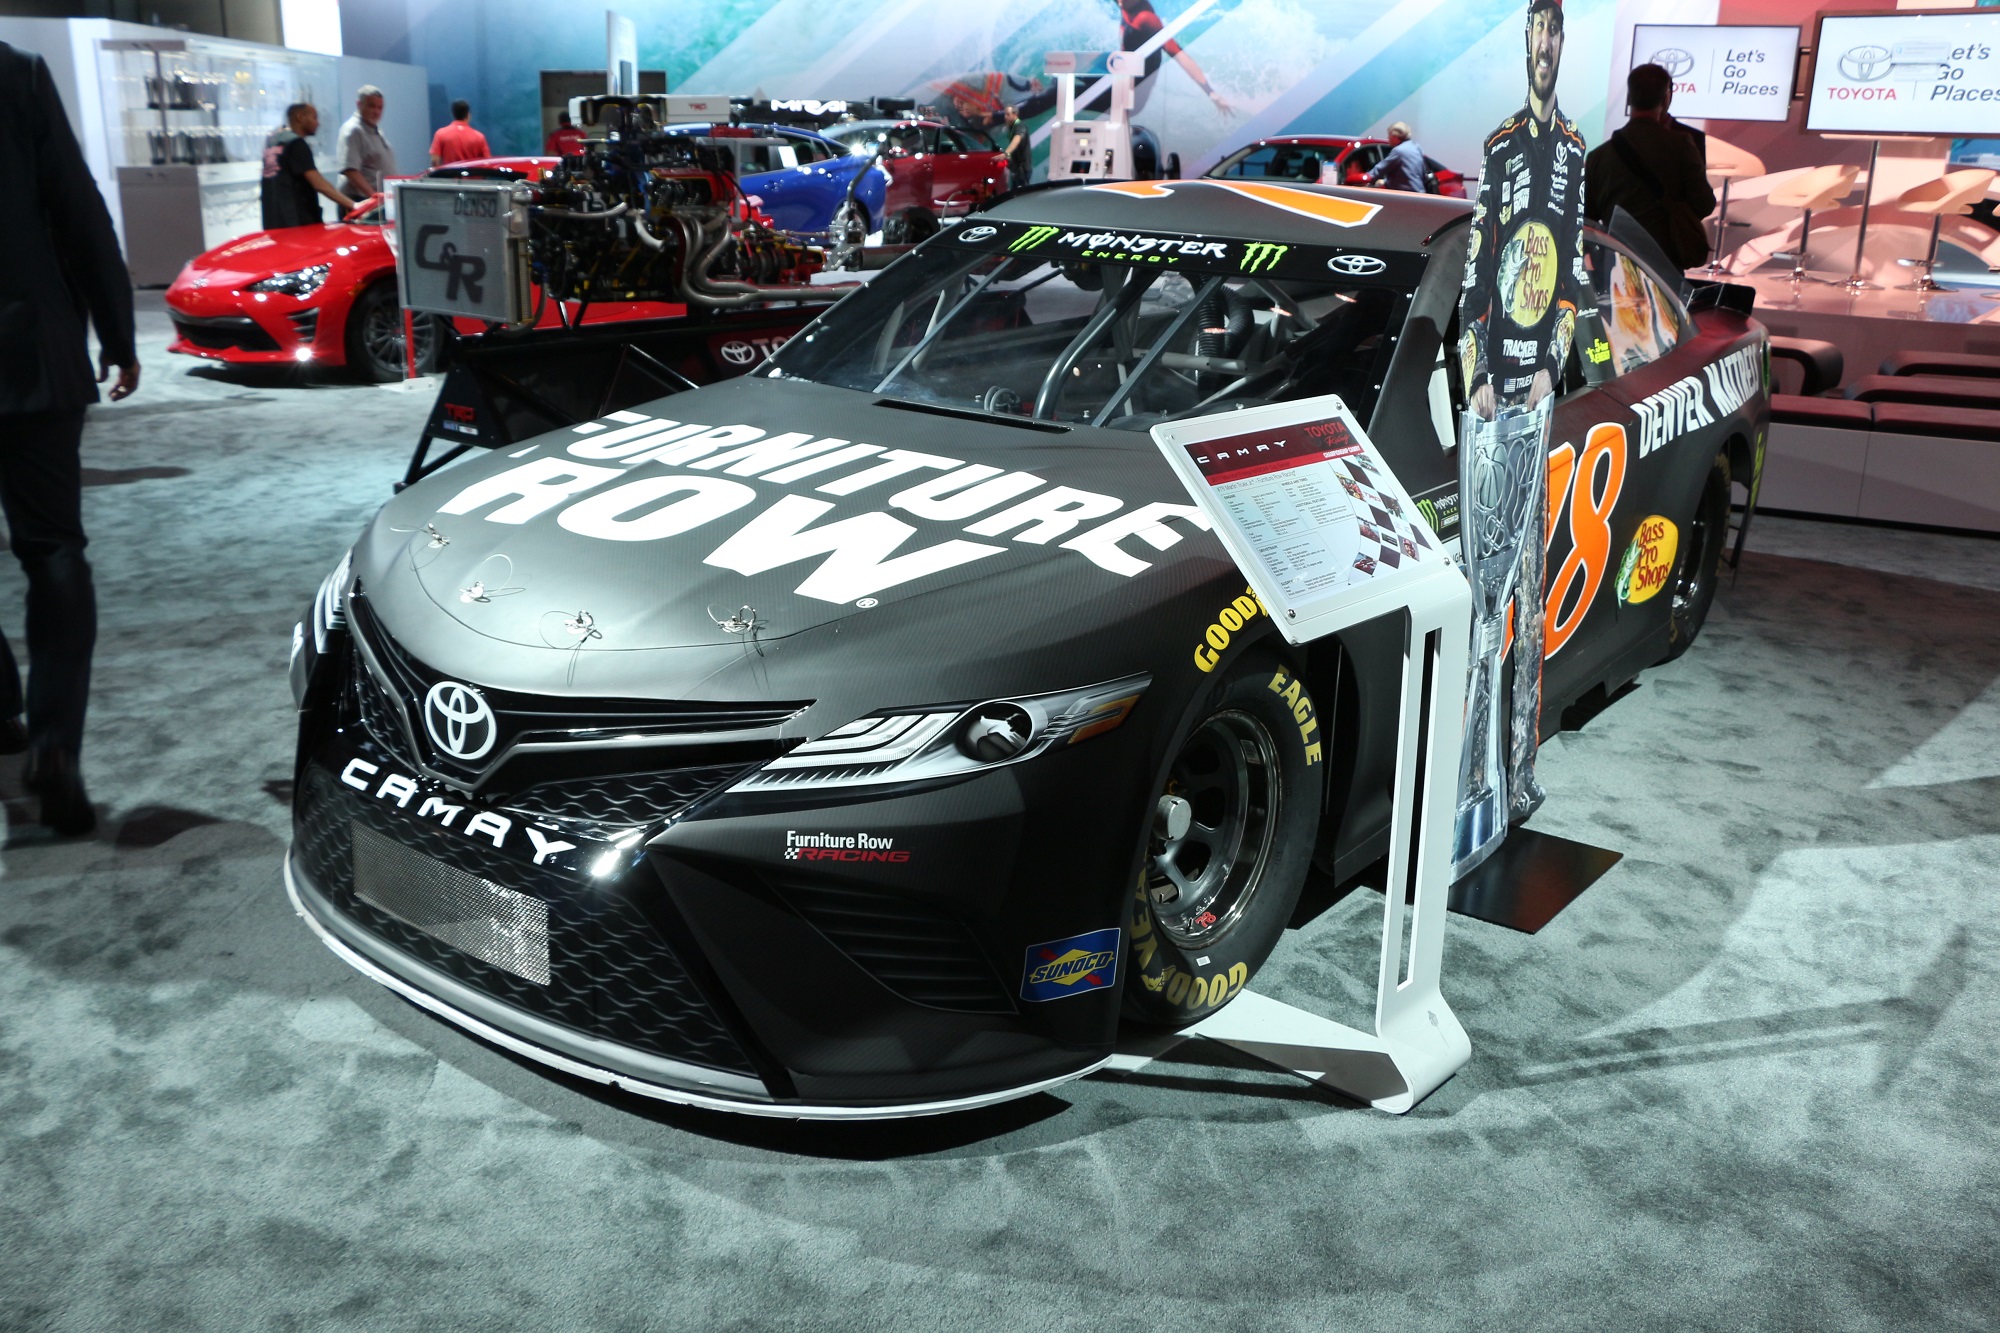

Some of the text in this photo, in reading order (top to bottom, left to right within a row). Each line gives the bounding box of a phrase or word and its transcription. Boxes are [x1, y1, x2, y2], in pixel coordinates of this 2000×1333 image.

[1725, 49, 1766, 63] Let's
[1946, 43, 1991, 61] et's
[1723, 65, 1747, 79] Go
[1672, 83, 1697, 94] OTA
[1721, 82, 1779, 96] Places
[1827, 87, 1897, 101] TOYOTA
[770, 99, 847, 116] MIRAI
[453, 197, 498, 218] DENSO
[1526, 225, 1549, 256] Bass
[1081, 249, 1179, 265] ENERGY
[1522, 255, 1541, 281] Pro
[1520, 282, 1549, 318] Shops
[1503, 338, 1538, 357] TRACKER
[1519, 357, 1536, 366] boats
[1630, 376, 1715, 459] DENVER
[1304, 422, 1347, 439] TOYOTA
[1197, 440, 1287, 464] CAMRY
[507, 410, 1213, 578] URNITURE
[436, 457, 1010, 605] ROW
[1638, 521, 1665, 548] Bass
[1637, 544, 1658, 568] Pro
[1635, 561, 1671, 591] Shops
[1268, 664, 1322, 766] EAGLE
[786, 830, 894, 850] Furniture Row
[797, 847, 912, 863] RACING
[1033, 951, 1113, 982] SUNOCO
